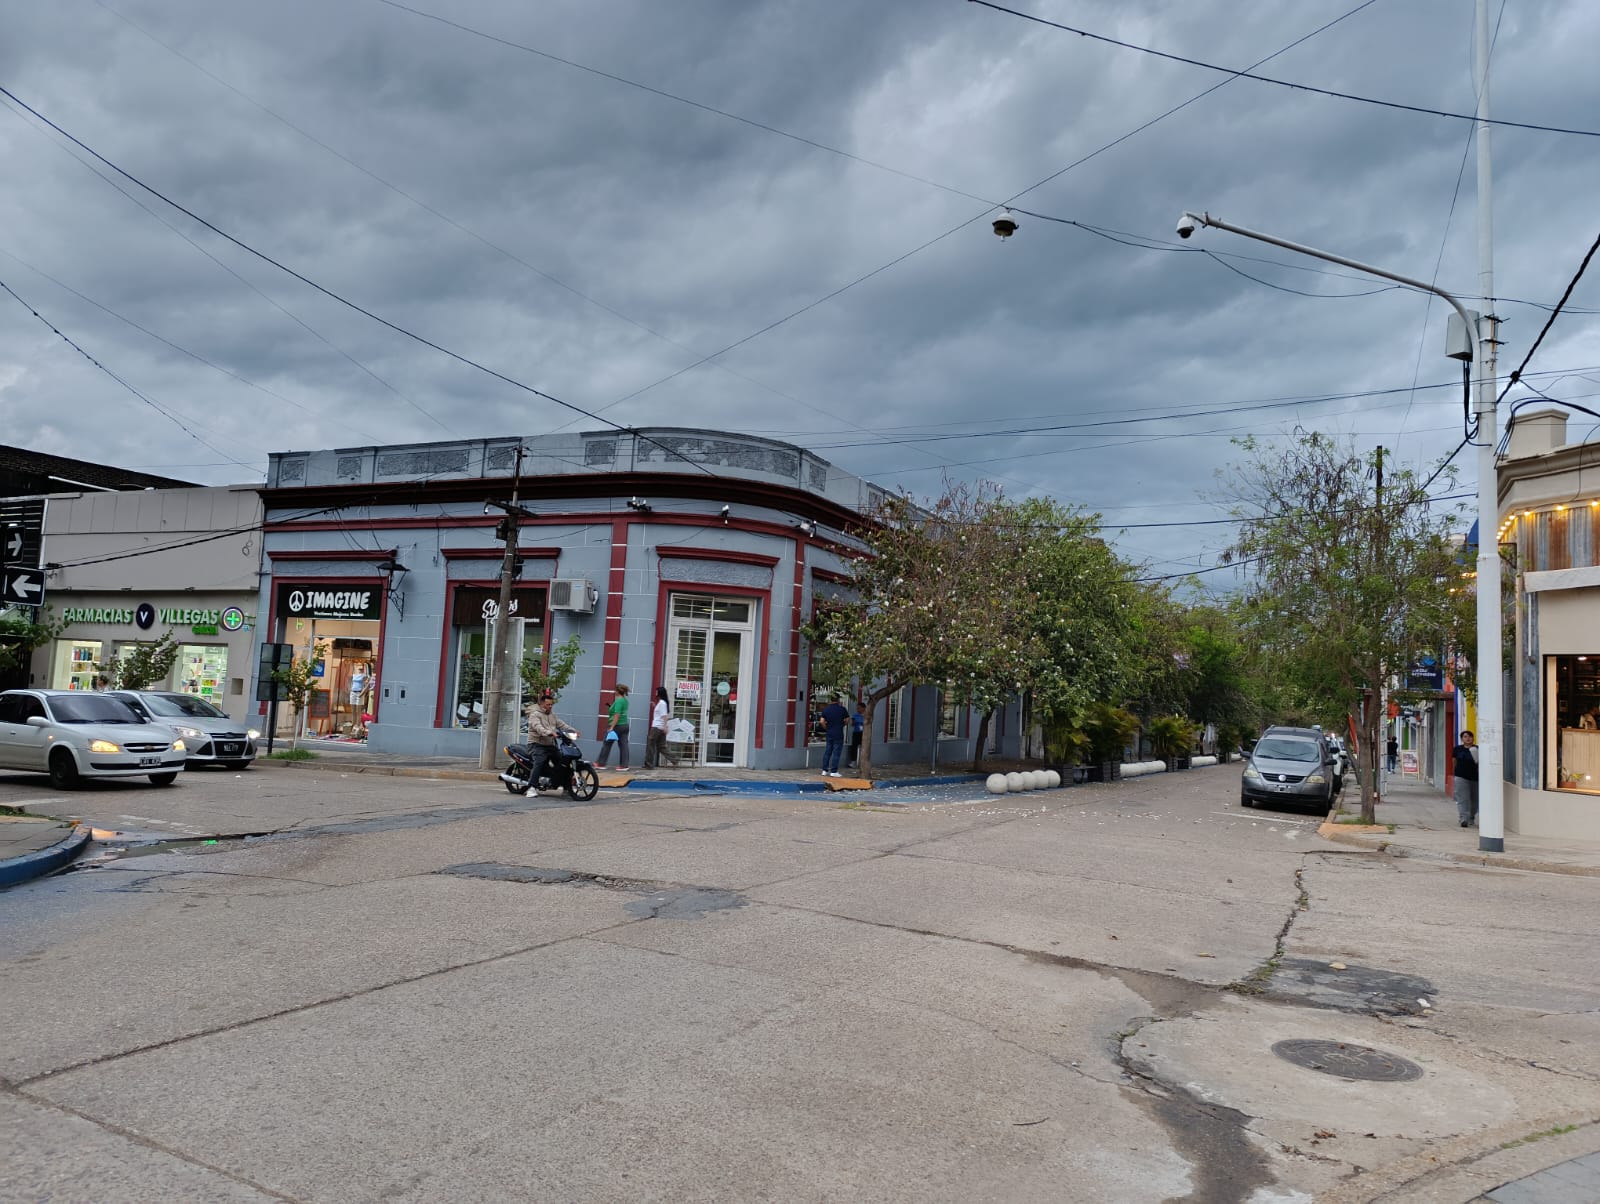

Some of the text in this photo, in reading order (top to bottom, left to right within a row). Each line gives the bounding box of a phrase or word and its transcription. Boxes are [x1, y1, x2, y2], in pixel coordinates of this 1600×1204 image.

[305, 591, 371, 610] IMAGINE
[62, 607, 219, 625] FARMACIAS V VILLEGAS
